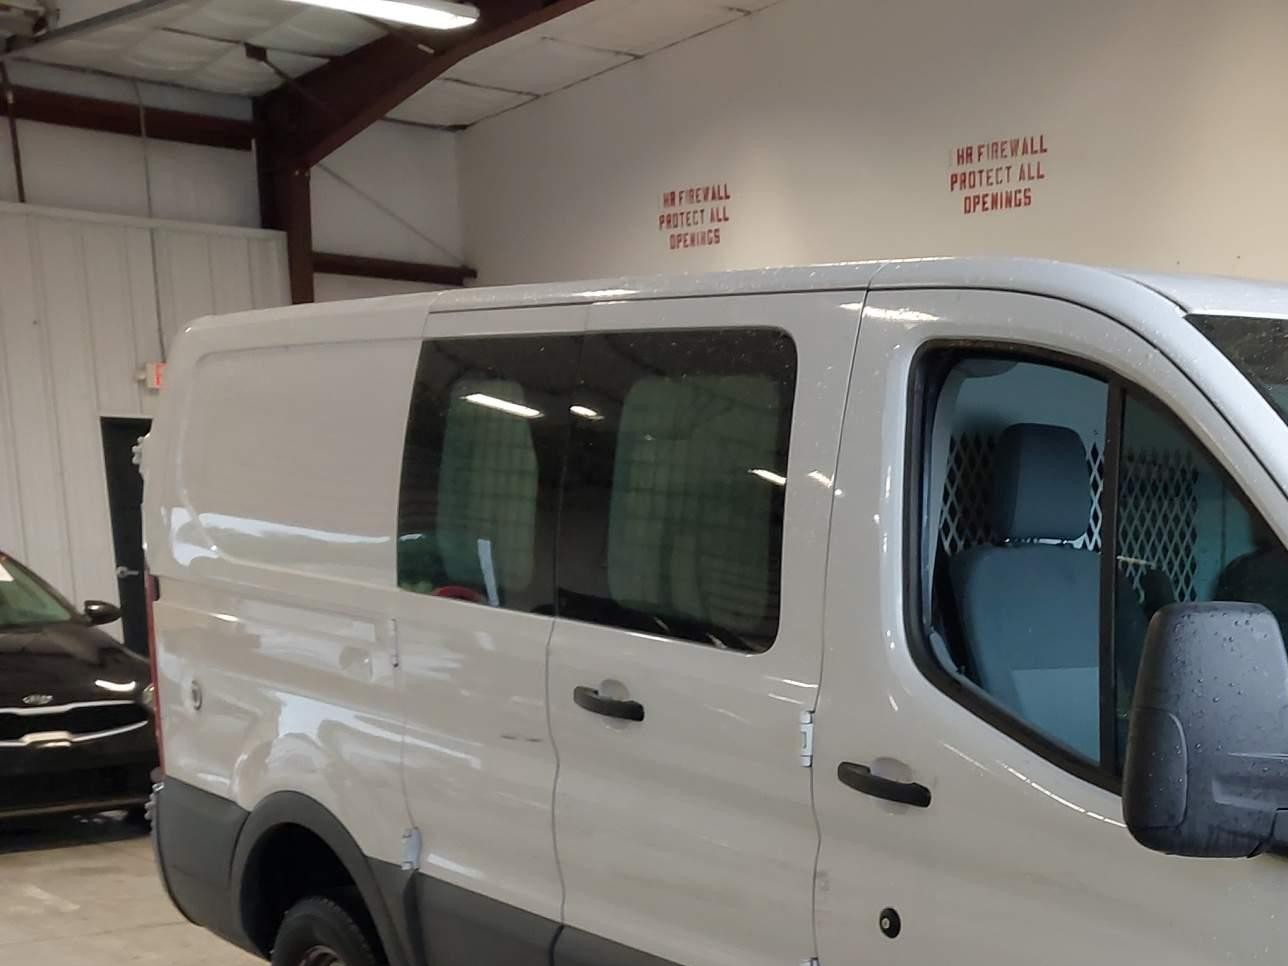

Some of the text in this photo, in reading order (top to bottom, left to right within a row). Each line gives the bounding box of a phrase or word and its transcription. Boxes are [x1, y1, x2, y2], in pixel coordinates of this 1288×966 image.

[977, 134, 1048, 162] FIREWALL
[950, 161, 1045, 192] PROTECT ALL
[679, 184, 730, 206] FIREWALL
[964, 188, 1031, 214] OPENINGS
[659, 206, 729, 230] PROTECT ALL
[670, 228, 720, 250] OPENINGS
